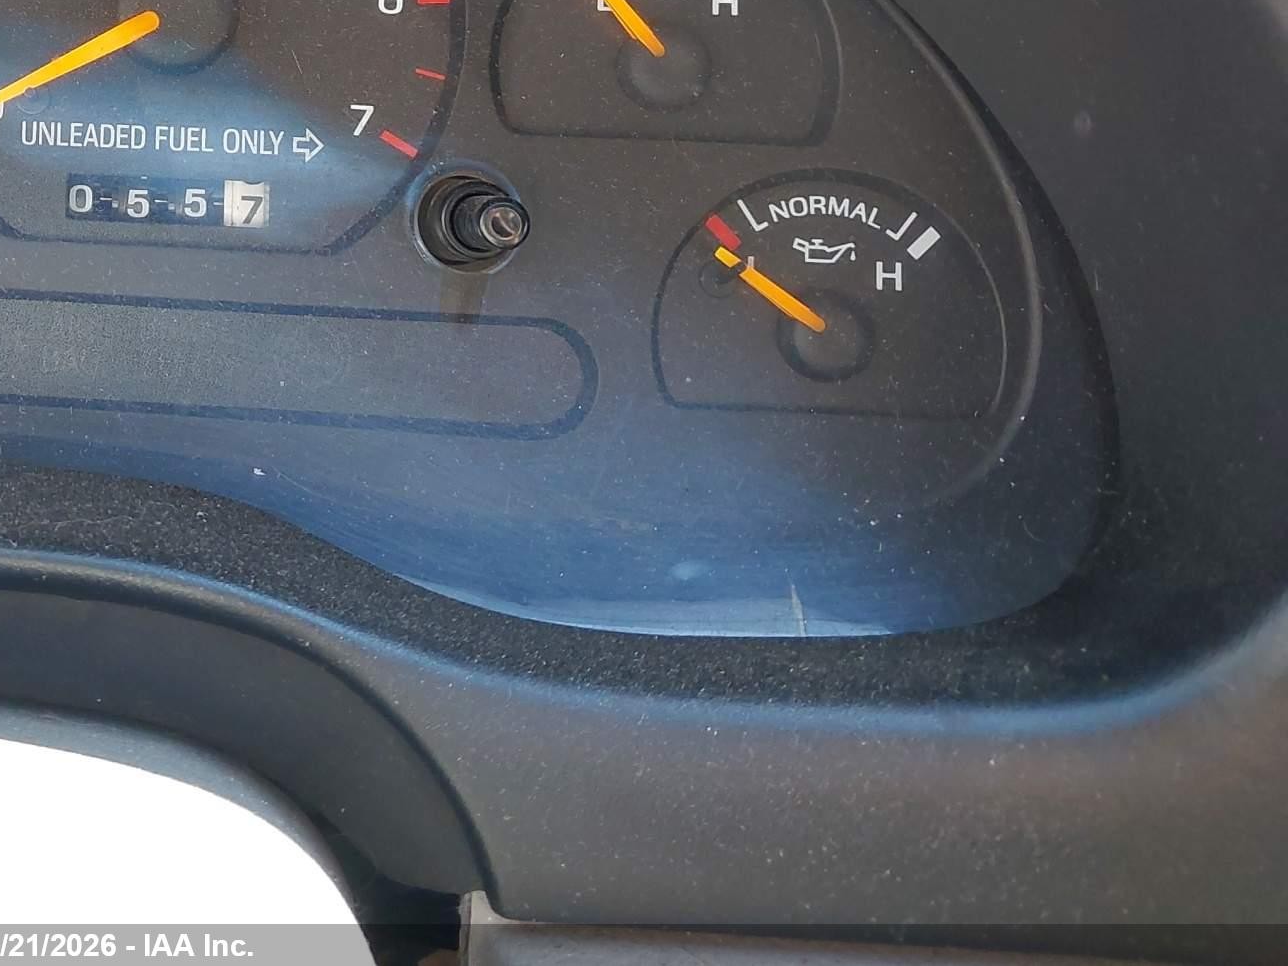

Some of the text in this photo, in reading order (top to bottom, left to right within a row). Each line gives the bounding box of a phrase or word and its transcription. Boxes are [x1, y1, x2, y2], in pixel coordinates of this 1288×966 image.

[351, 105, 373, 135] 7
[22, 121, 284, 155] UNLEADED FUEL ONLY
[769, 196, 880, 229] NORMAL
[876, 262, 902, 291] H
